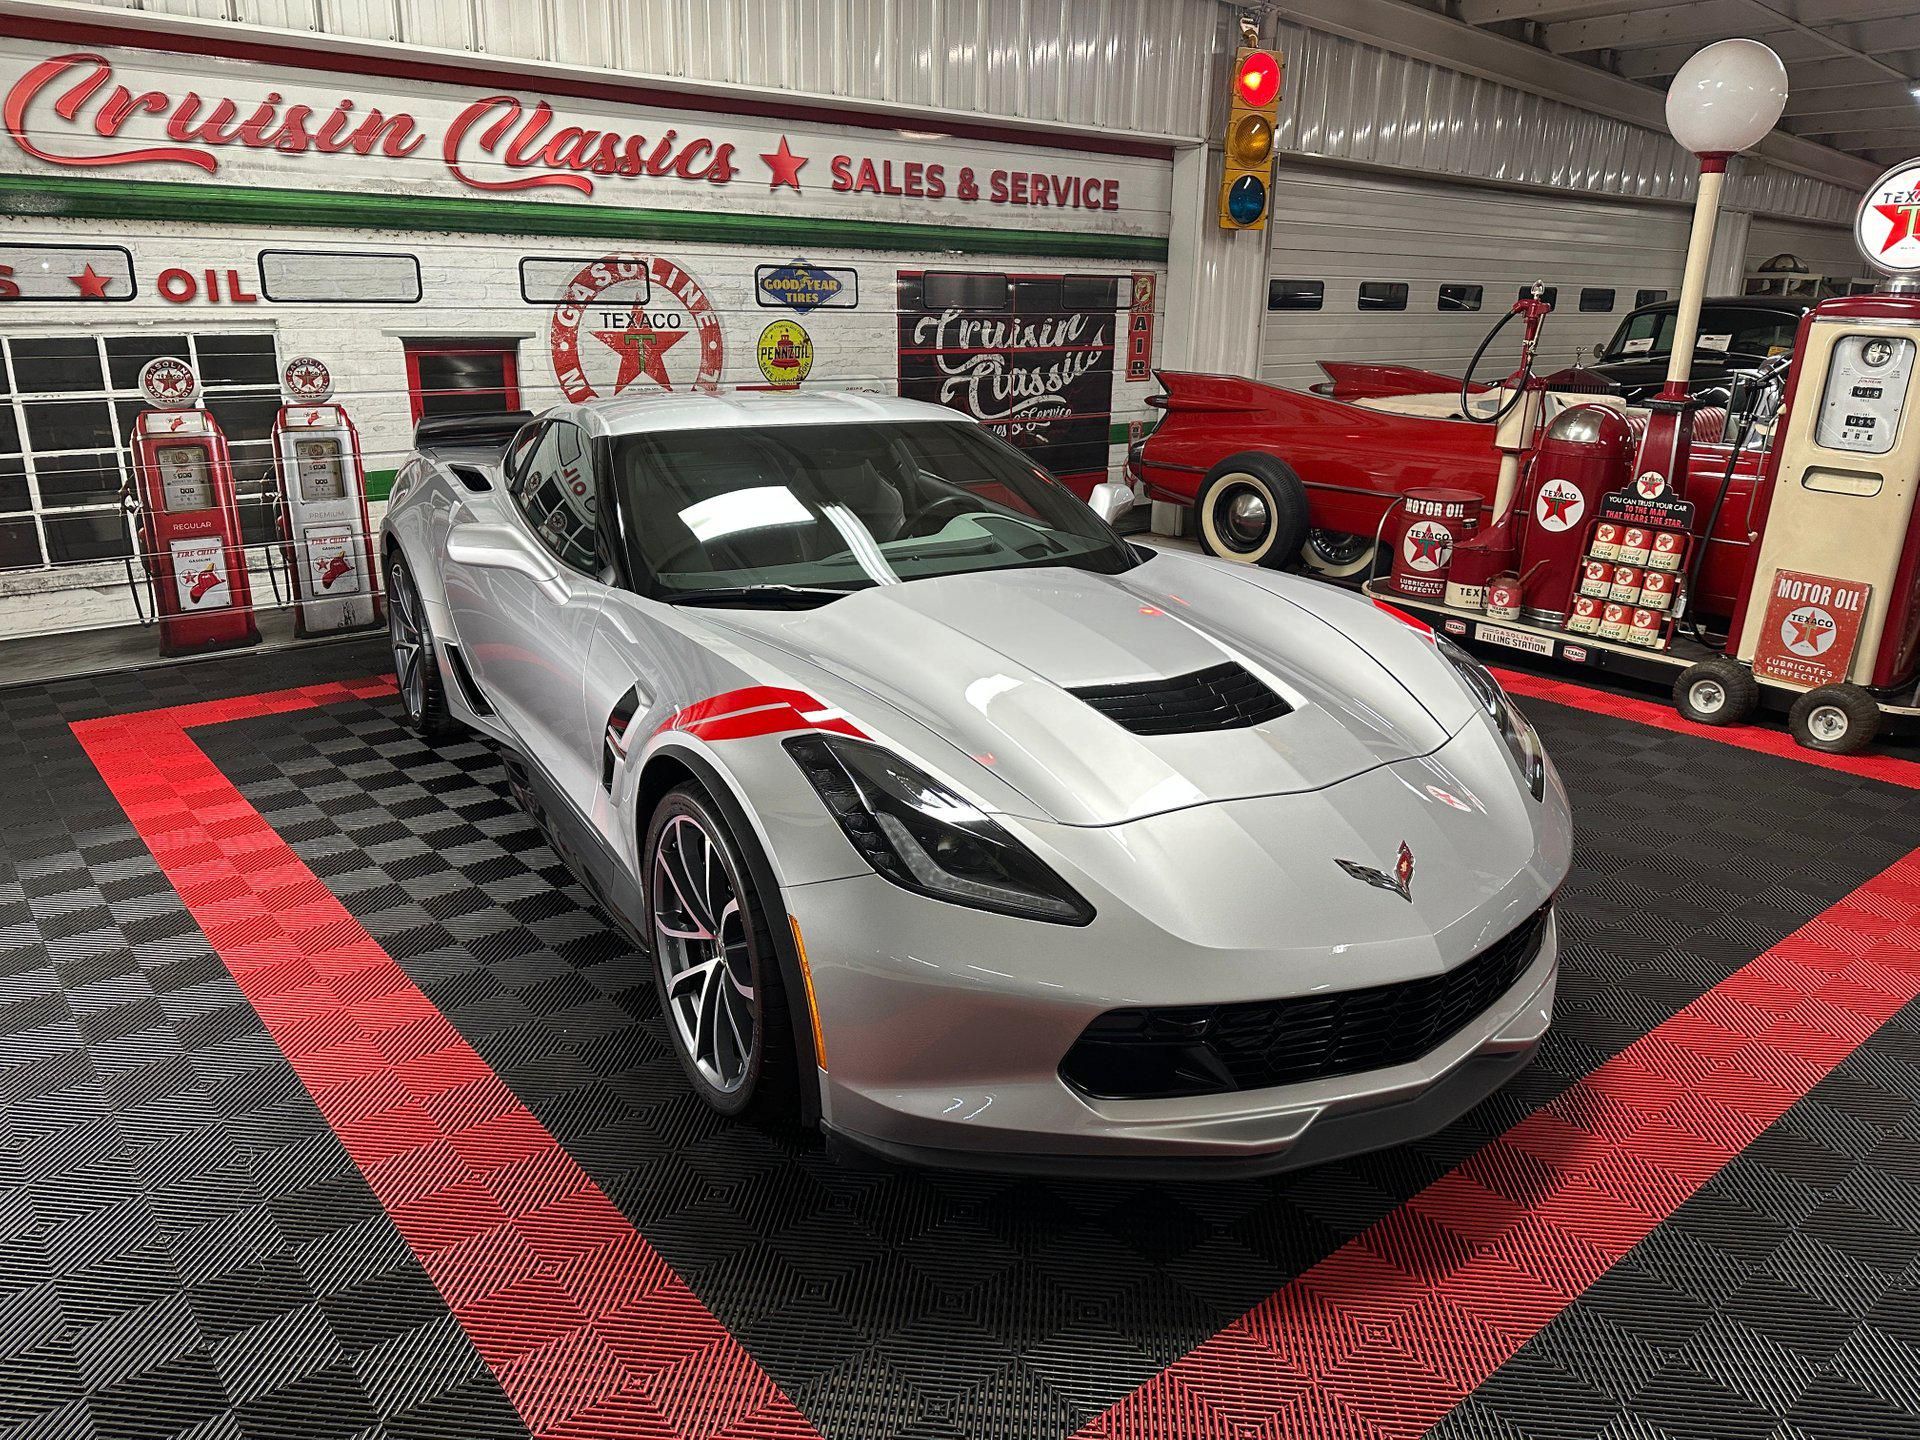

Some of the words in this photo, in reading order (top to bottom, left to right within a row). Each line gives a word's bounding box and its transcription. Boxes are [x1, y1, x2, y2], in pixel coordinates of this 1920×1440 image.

[4, 53, 426, 174] Cruisin
[443, 95, 739, 196] Classics
[831, 155, 946, 198] SALES
[957, 167, 979, 201] &
[990, 169, 1120, 210] SERVICE
[157, 267, 257, 303] OIL
[557, 255, 716, 331] GASOLINE
[785, 292, 819, 303] TIRES
[599, 312, 681, 329] TEXACO
[914, 308, 1088, 375] Cruisin
[1131, 315, 1148, 376] AIR
[760, 344, 810, 361] PENNZOIL
[146, 361, 191, 379] GASOLINE
[1544, 489, 1577, 500] TEXACO
[1405, 498, 1443, 517] MOTOR
[1446, 503, 1465, 518] OIL
[1609, 496, 1621, 504] YOU
[1622, 498, 1637, 506] CAN
[1638, 499, 1655, 508] TRUST
[1656, 502, 1673, 510] YOUR
[1674, 504, 1688, 512] CAR
[1625, 504, 1634, 513] TO
[1635, 506, 1647, 514] THE
[1649, 508, 1668, 517] MAN
[309, 510, 345, 519] PREMIUM
[1606, 510, 1623, 519] THAT
[1624, 512, 1648, 524] WEARS
[1650, 516, 1662, 524] THE
[173, 521, 212, 531] REGULAR
[1410, 529, 1450, 542] TEXACO
[1400, 578, 1444, 589] LUBRICATES
[1400, 584, 1441, 594] PERFECTLY
[1777, 578, 1832, 606] MOTOR
[1834, 588, 1859, 611] OIL
[1791, 613, 1834, 628] TEXACO
[1482, 632, 1511, 645] FILLING
[1512, 638, 1546, 653] STATION
[1494, 629, 1535, 641] GASOLINE
[1565, 649, 1585, 658] TEXACO
[1766, 657, 1833, 678] LUBRICATES
[1767, 666, 1828, 685] PERFECTLY
